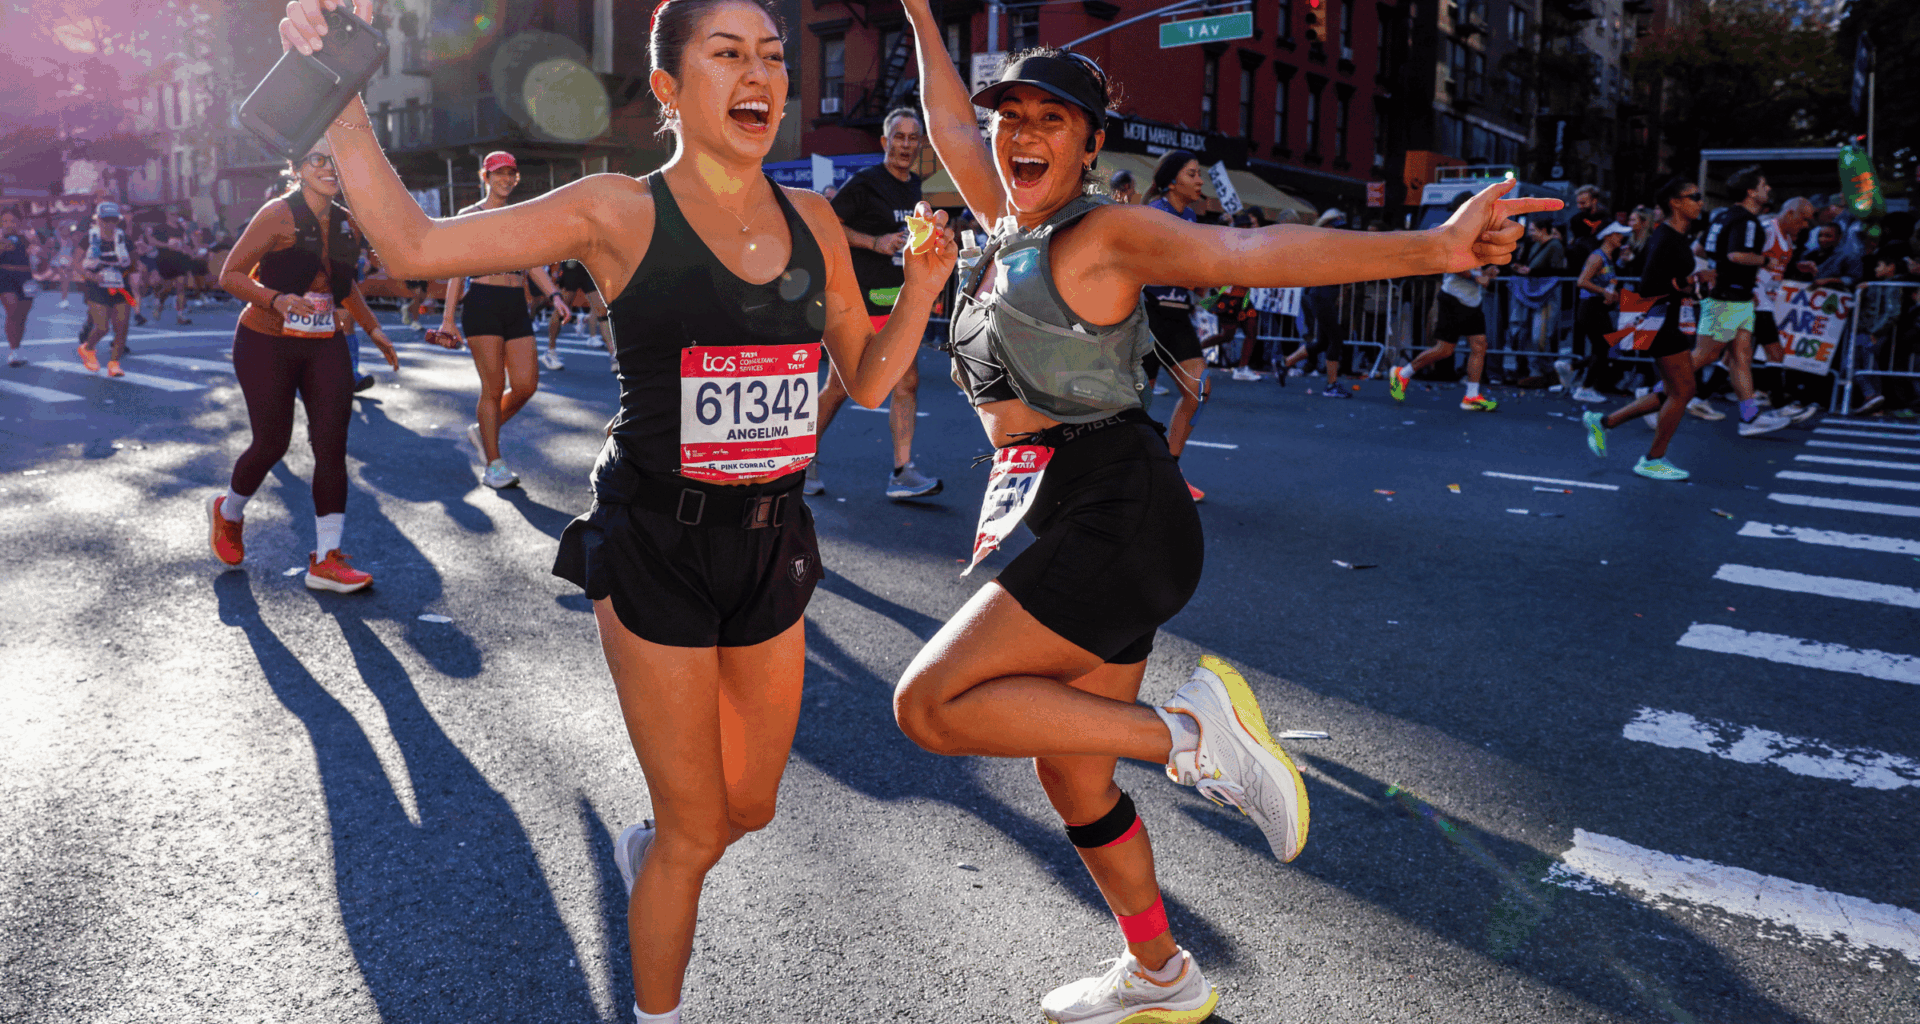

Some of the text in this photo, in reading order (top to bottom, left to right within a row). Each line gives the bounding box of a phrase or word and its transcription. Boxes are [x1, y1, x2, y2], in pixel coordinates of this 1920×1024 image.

[1188, 25, 1194, 38] 1
[1778, 309, 1828, 336] ARE
[702, 352, 737, 372] tcs
[740, 357, 778, 366] CONSULTANCY
[695, 377, 810, 425] 61342
[726, 426, 789, 441] ANGELINA
[708, 463, 717, 471] 5
[739, 462, 767, 470] CORRAL
[767, 459, 776, 469] C
